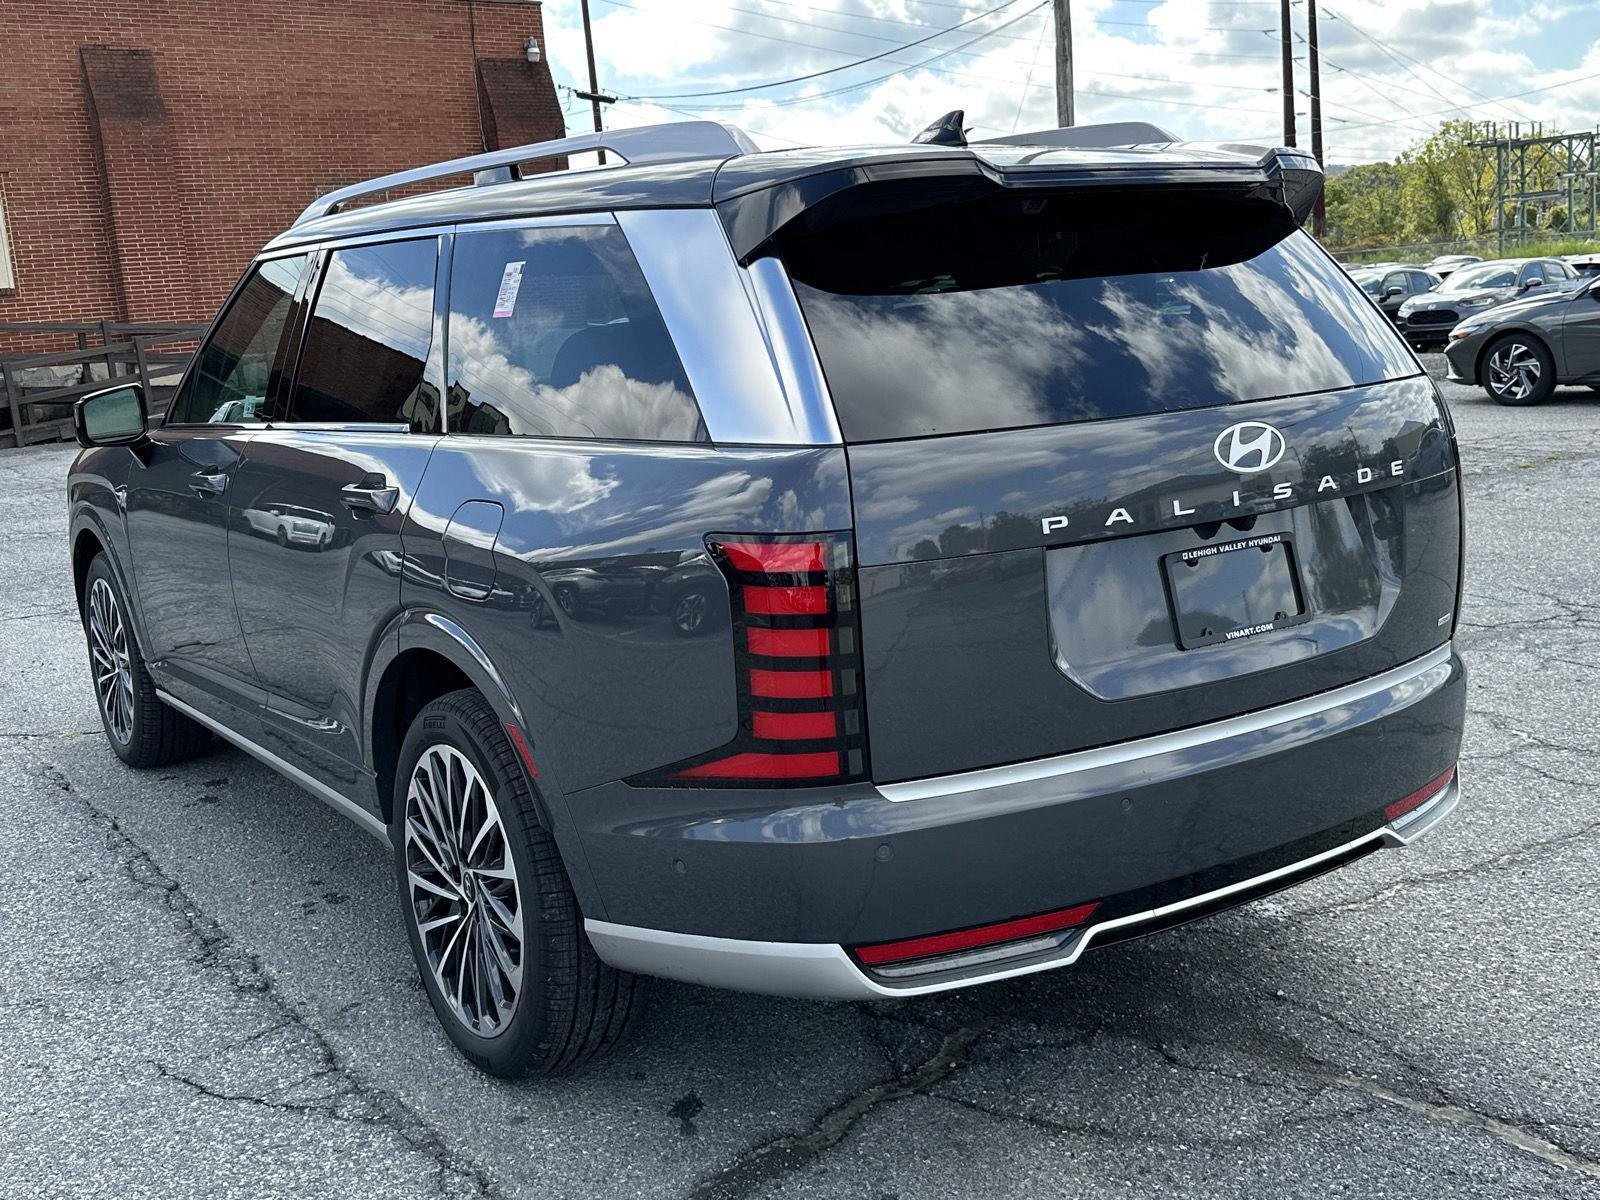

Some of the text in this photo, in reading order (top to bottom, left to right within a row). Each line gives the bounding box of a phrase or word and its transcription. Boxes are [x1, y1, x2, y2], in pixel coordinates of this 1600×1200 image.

[1041, 460, 1404, 535] PALISADE
[1188, 535, 1281, 559] LEHIGH VALLEY HYUNDAI
[1225, 623, 1274, 640] VINART.COM
